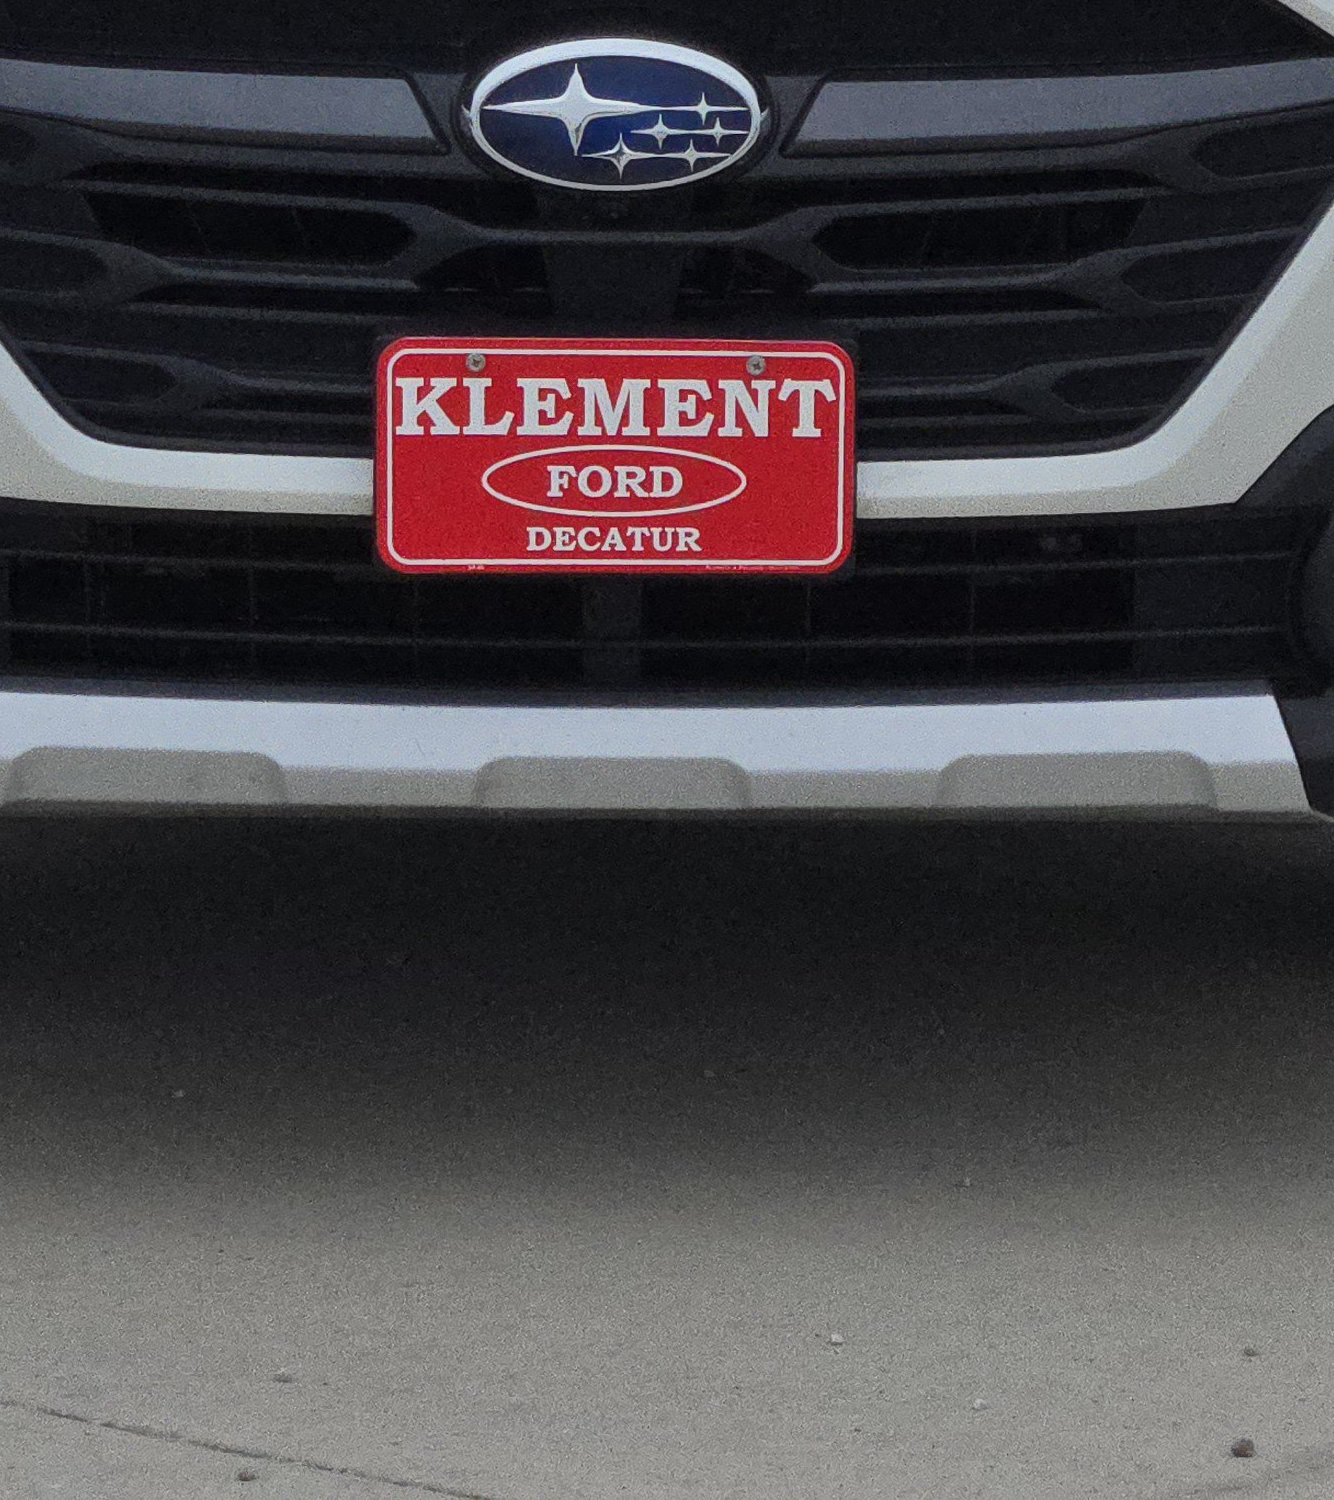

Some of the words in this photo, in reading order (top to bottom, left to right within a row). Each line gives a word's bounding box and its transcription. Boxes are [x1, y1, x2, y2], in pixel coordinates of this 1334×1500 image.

[394, 376, 837, 438] KLEMENT
[546, 465, 684, 499] FORD
[526, 526, 702, 552] DECATUR
